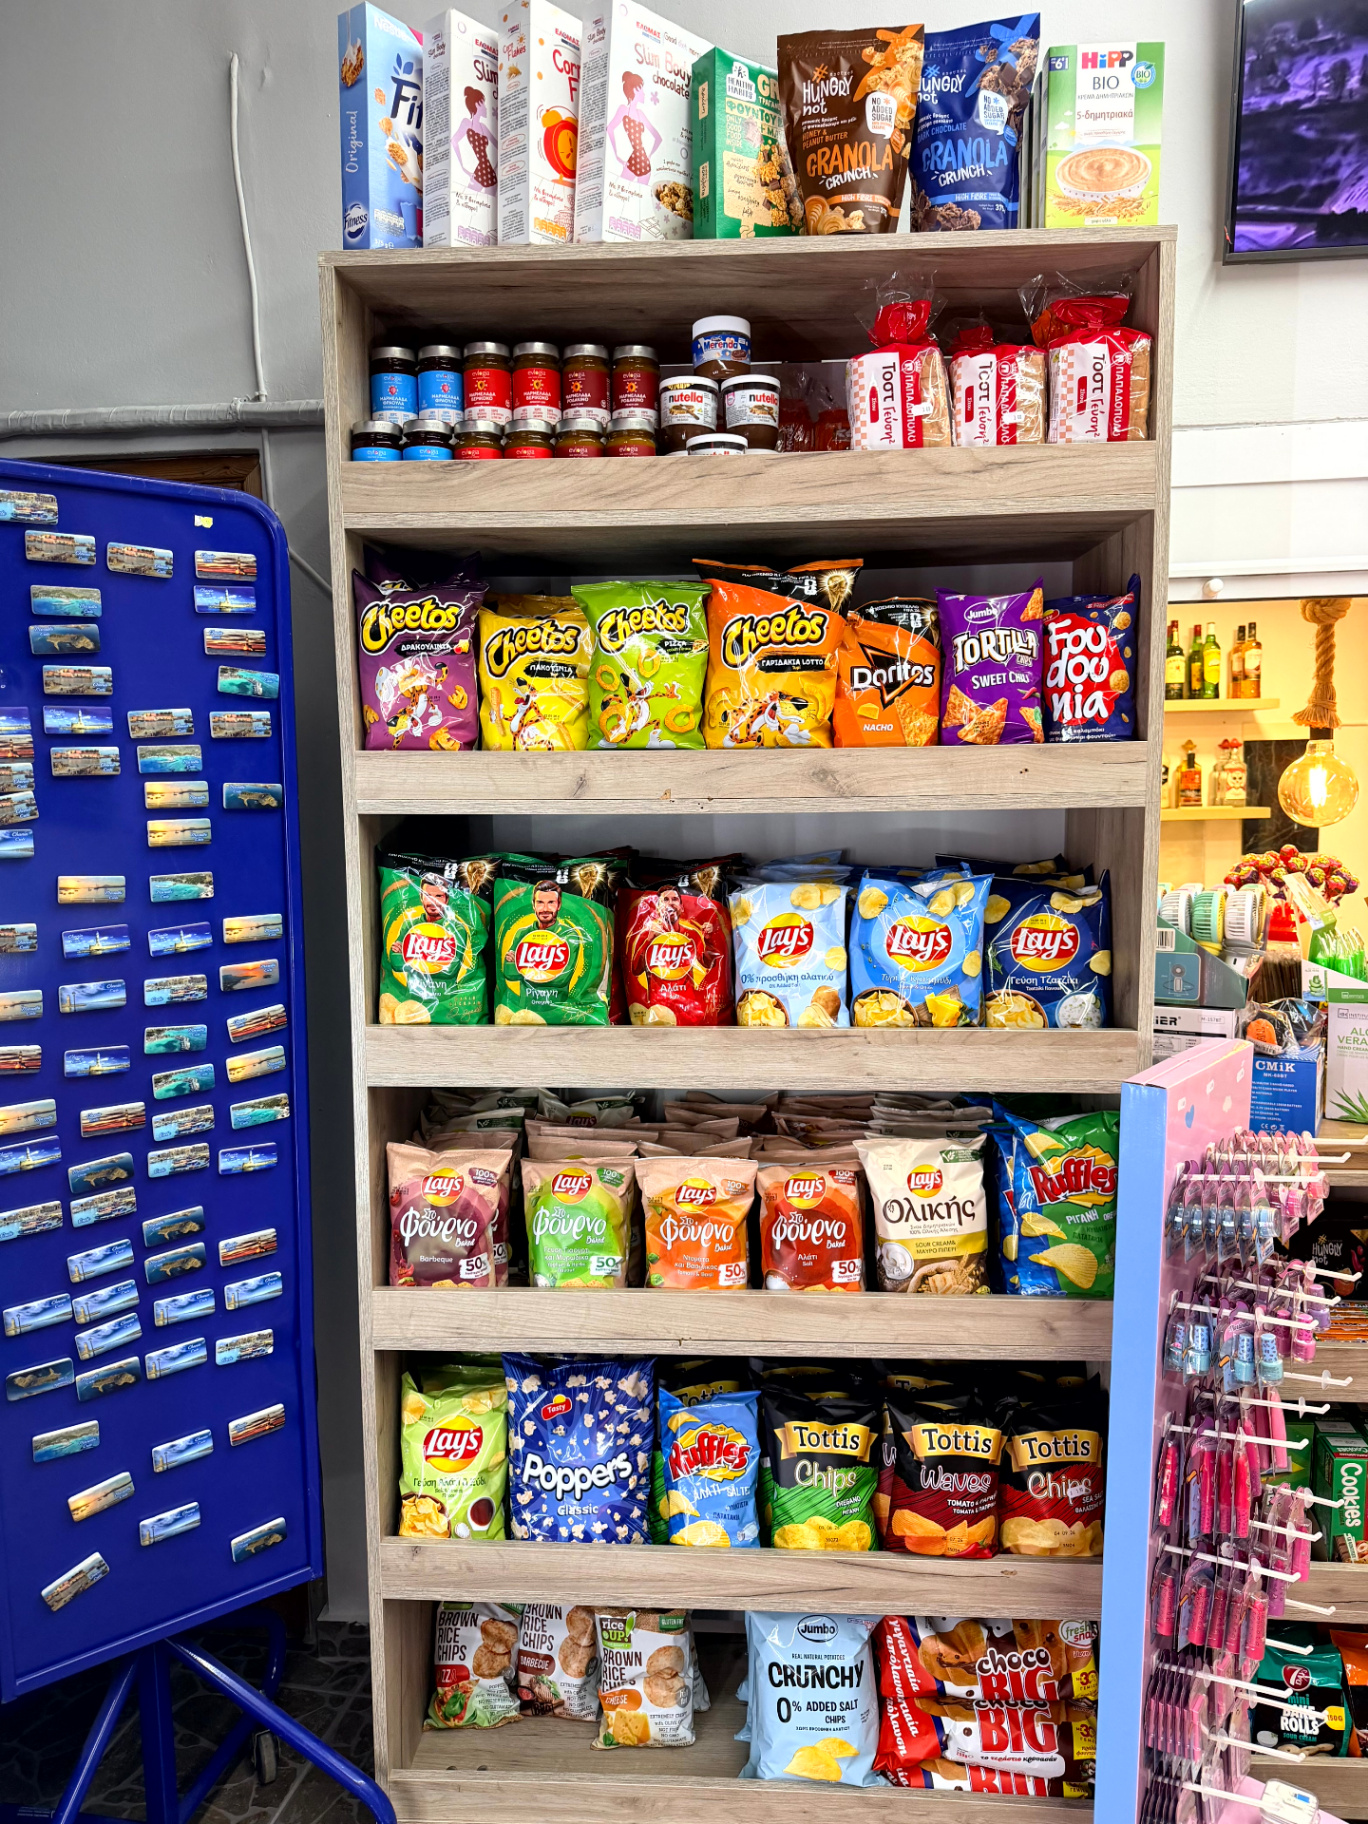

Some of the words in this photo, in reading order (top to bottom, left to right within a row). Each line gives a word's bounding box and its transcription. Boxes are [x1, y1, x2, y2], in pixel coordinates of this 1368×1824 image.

[634, 42, 661, 69] Slim
[665, 50, 692, 88] Body
[1082, 51, 1134, 70] HiPP
[1092, 75, 1120, 90] BIO
[1135, 69, 1150, 79] BIO
[652, 70, 690, 100] chocolate
[802, 103, 828, 116] not
[872, 96, 882, 105] NO
[983, 95, 992, 105] NO
[983, 104, 1004, 113] ADDED
[871, 105, 893, 115] ADDED
[871, 113, 893, 122] SUGAR
[983, 112, 1005, 120] SUGAR
[803, 129, 821, 141] HONEY
[931, 121, 967, 136] CHOCOLATE
[345, 110, 364, 174] Original
[803, 137, 824, 150] PEANUT
[825, 132, 849, 143] BUTTER
[806, 140, 894, 177] GRANOLA
[922, 136, 1009, 174] GRANOLA
[825, 165, 872, 190] CRUNCH
[938, 164, 985, 188] CRUNCH
[856, 194, 874, 202] FIBRE
[955, 193, 969, 202] HIGH
[970, 192, 988, 202] FIBRE
[344, 212, 368, 230] Fitness
[704, 340, 738, 350] Merenda
[669, 392, 703, 403] nutella
[749, 392, 778, 406] nutella
[967, 609, 997, 620] Jumbo
[361, 597, 462, 654] Cheetos
[598, 600, 689, 653] Cheetos
[664, 640, 687, 648] PIZZA
[723, 606, 828, 668] Cheetos
[1047, 618, 1108, 656] Fou
[487, 620, 581, 678] Cheetos
[953, 630, 1038, 676] TORTILLA
[802, 658, 824, 667] LOTTO
[1046, 647, 1110, 688] dou
[852, 665, 935, 688] Doritos
[971, 675, 1007, 690] SWEET
[1008, 671, 1030, 685] CHILI
[1051, 683, 1109, 722] nia
[863, 723, 894, 732] NACHO
[406, 934, 453, 963] Lay's
[761, 926, 812, 957] Lay's
[889, 925, 950, 962] Lay's
[1014, 928, 1076, 960] Lay's
[518, 943, 567, 972] Lay's
[650, 943, 692, 970] Lay's
[660, 984, 687, 993] Αλάτι
[741, 974, 755, 985] 0%
[800, 973, 834, 983] αλατιού
[1010, 976, 1038, 988] Γεύση
[1255, 1060, 1296, 1073] CMiK
[423, 1175, 463, 1197] Lay's
[552, 1174, 590, 1196] Lay's
[787, 1177, 825, 1200] Lay's
[910, 1171, 942, 1190] Lay's
[1028, 1157, 1118, 1206] Ruffles
[677, 1185, 716, 1206] Lay's
[882, 1197, 976, 1226] Ολικής
[1066, 1209, 1099, 1224] ΡΙΓΑΝΗ
[400, 1206, 478, 1247] φούρνο
[533, 1205, 606, 1245] φούρνο
[659, 1214, 734, 1250] φούρνο
[772, 1212, 846, 1250] φούρνο
[420, 1255, 453, 1264] Barbeque
[1311, 1253, 1328, 1265] not
[546, 1403, 567, 1414] Tasty
[425, 1428, 483, 1460] Lay's
[794, 1426, 860, 1451] Tottis
[922, 1428, 992, 1453] Tottis
[1021, 1434, 1091, 1460] Tottis
[669, 1430, 754, 1483] Ruffles
[413, 1478, 438, 1488] Γεύση
[522, 1453, 632, 1500] Poppers
[795, 1459, 856, 1498] Chips
[920, 1465, 992, 1493] Waves
[693, 1485, 721, 1501] ΑΛΑΤΙ
[1027, 1471, 1093, 1506] Chips
[1340, 1462, 1363, 1528] Cookies
[557, 1504, 599, 1515] Classic
[947, 1499, 974, 1508] TOMATO
[1082, 1496, 1094, 1504] SEA
[438, 1611, 479, 1628] BROWN
[524, 1616, 547, 1633] RICE
[602, 1619, 625, 1630] rice
[437, 1627, 461, 1643] RICE
[801, 1624, 835, 1635] Jumbo
[1065, 1621, 1091, 1640] fresh
[522, 1632, 555, 1651] CHIPS
[438, 1644, 467, 1661] CHIPS
[603, 1647, 643, 1666] BROWN
[888, 1619, 921, 1693] γιγαντιαία
[977, 1648, 1050, 1674] choco
[520, 1656, 550, 1670] BARBECUE
[603, 1667, 626, 1681] RICE
[768, 1660, 865, 1689] CRUNCHY
[980, 1667, 1059, 1700] BIG
[605, 1694, 628, 1704] CHEESE
[1288, 1692, 1310, 1705] mini
[776, 1697, 802, 1723] 0%
[806, 1701, 837, 1712] ADDED
[839, 1699, 859, 1711] SALT
[825, 1715, 846, 1724] CHIPS
[976, 1707, 1059, 1754] BIG
[1280, 1716, 1320, 1736] ROLLS
[990, 1755, 1022, 1763] τεράστιο
[1022, 1755, 1058, 1765] κρουασάν
